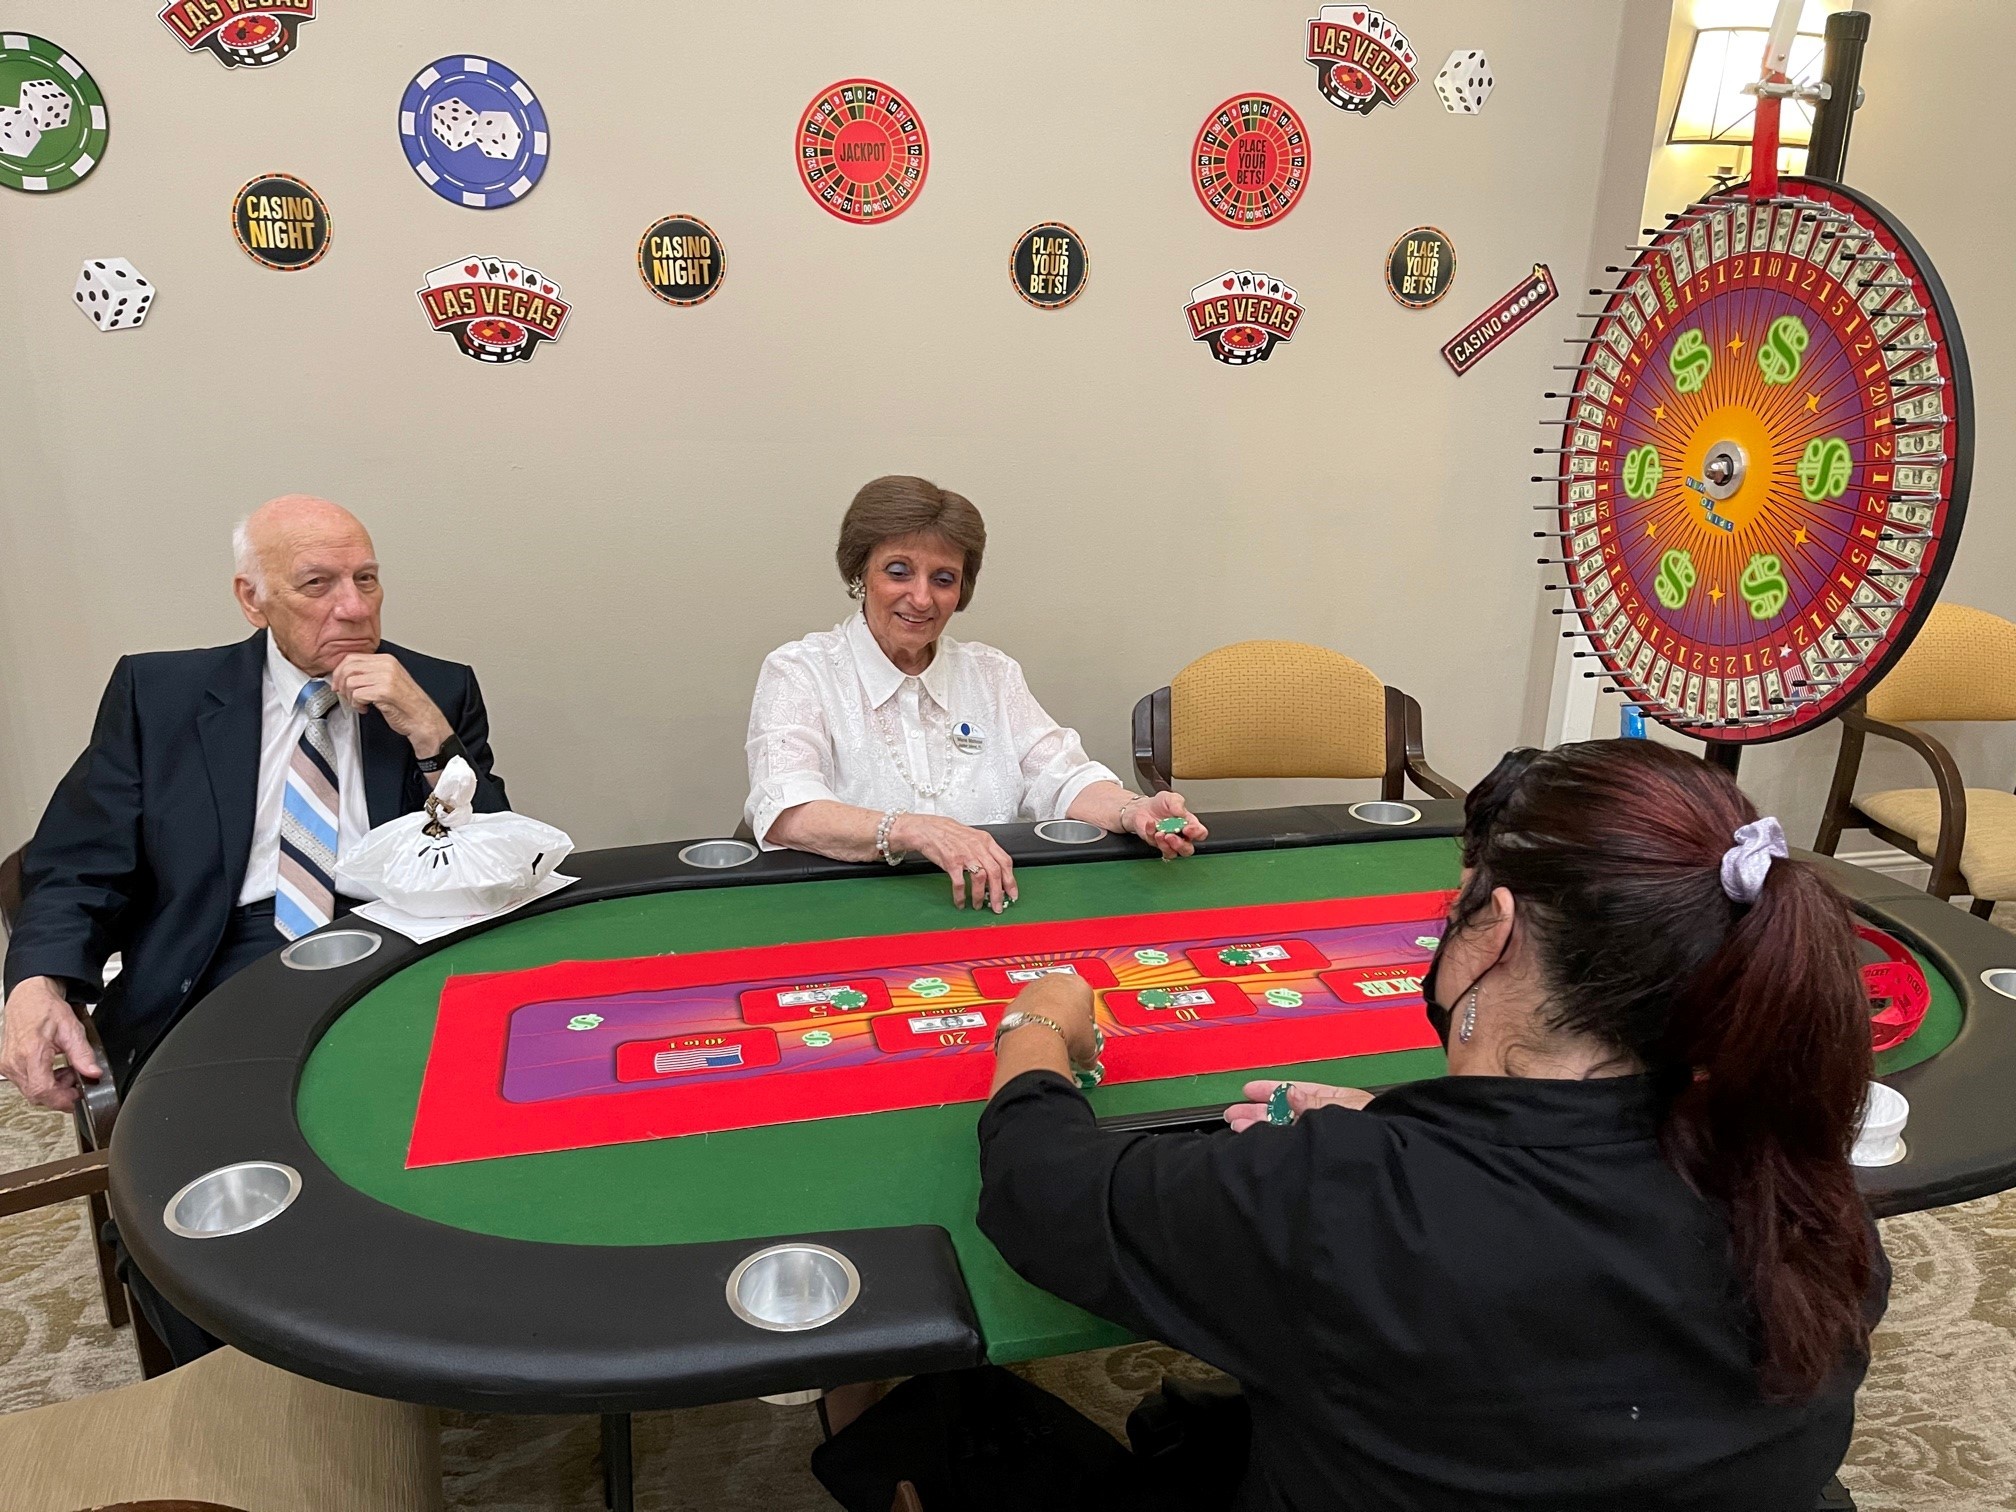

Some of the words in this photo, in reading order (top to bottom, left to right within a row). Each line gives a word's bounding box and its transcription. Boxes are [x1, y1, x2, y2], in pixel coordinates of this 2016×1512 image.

[169, 0, 223, 39] LAS
[1314, 27, 1351, 57] LAS
[1353, 36, 1411, 95] VEGAS
[844, 91, 854, 101] 28
[857, 90, 862, 99] 0
[867, 91, 876, 100] 21
[821, 103, 832, 114] 26
[888, 102, 898, 112] 18
[1253, 104, 1258, 112] 0
[1261, 105, 1270, 114] 21
[903, 121, 914, 132] 19
[1220, 115, 1229, 125] 26
[809, 125, 818, 133] 11
[1206, 134, 1216, 143] 11
[1239, 139, 1266, 153] PLACE
[806, 147, 815, 157] 20
[840, 143, 886, 162] JACKPOT
[910, 146, 919, 154] 12
[1201, 156, 1209, 165] 20
[1239, 154, 1266, 169] YOUR
[1294, 158, 1302, 166] 12
[810, 170, 820, 180] 17
[907, 168, 917, 178] 25
[1237, 170, 1265, 184] BETS!
[1203, 178, 1212, 186] 17
[1289, 178, 1298, 188] 25
[824, 188, 834, 198] 22
[898, 185, 907, 196] 27
[246, 195, 314, 220] CASINO
[842, 200, 851, 209] 15
[882, 199, 891, 208] 13
[1212, 195, 1222, 205] 22
[1278, 195, 1287, 205] 27
[863, 204, 872, 213] 00
[1228, 207, 1235, 216] 15
[1246, 210, 1254, 219] 00
[1263, 206, 1272, 216] 13
[248, 220, 315, 250] NIGHT
[651, 236, 711, 258] CASINO
[1032, 237, 1069, 255] PLACE
[1407, 240, 1441, 257] PLACE
[653, 259, 711, 285] NIGHT
[1032, 254, 1069, 275] YOUR
[1407, 257, 1439, 276] YOUR
[1734, 260, 1744, 279] 2
[1752, 257, 1761, 276] 1
[1767, 258, 1782, 277] 10
[1786, 262, 1798, 283] 1
[1717, 265, 1726, 284] 1
[1801, 270, 1816, 290] 2
[1030, 275, 1067, 294] BETS!
[1402, 276, 1437, 295] BETS!
[1654, 254, 1678, 315] JOKER
[1700, 273, 1709, 293] 5
[1683, 285, 1693, 303] 1
[1817, 281, 1832, 303] 1
[427, 287, 476, 321] LAS
[479, 286, 562, 330] VEGAS
[1832, 296, 1848, 316] 5
[1191, 300, 1229, 332] LAS
[1233, 298, 1298, 332] VEGAS
[1654, 315, 1665, 332] 1
[1845, 314, 1861, 336] 1
[1454, 317, 1502, 362] CASINO
[1641, 332, 1653, 350] 2
[1855, 335, 1872, 356] 2
[1631, 352, 1642, 367] 1
[1864, 360, 1881, 379] 1
[1620, 373, 1631, 388] 5
[1613, 394, 1624, 407] 1
[1870, 382, 1888, 406] 20
[1606, 415, 1617, 430] 2
[1874, 413, 1891, 430] 1
[1602, 438, 1613, 448] 1
[1875, 442, 1892, 458] 2
[1599, 460, 1610, 472] 5
[1873, 471, 1889, 484] 1
[1598, 482, 1608, 492] 1
[1599, 500, 1610, 519] 20
[1867, 496, 1885, 513] 2
[1601, 524, 1611, 537] 1
[1860, 524, 1878, 539] 1
[1604, 543, 1616, 559] 2
[1851, 548, 1868, 567] 5
[1610, 564, 1622, 578] 1
[1618, 581, 1630, 597] 5
[1838, 572, 1855, 590] 1
[1626, 597, 1639, 614] 2
[1626, 598, 1639, 614] 2
[1825, 591, 1842, 613] 10
[1636, 613, 1650, 631] 10
[1810, 611, 1826, 630] 1
[1649, 625, 1660, 643] 1
[1794, 626, 1809, 646] 2
[1663, 637, 1675, 655] 2
[1678, 646, 1687, 664] 1
[1692, 652, 1704, 670] 2
[1743, 654, 1754, 672] 1
[1760, 647, 1773, 667] 2
[1709, 656, 1720, 674] 5
[1726, 656, 1736, 675] 2
[809, 1006, 828, 1018] 5
[1175, 1008, 1200, 1021] 10
[704, 1037, 727, 1047] 40
[939, 1031, 970, 1046] 20
